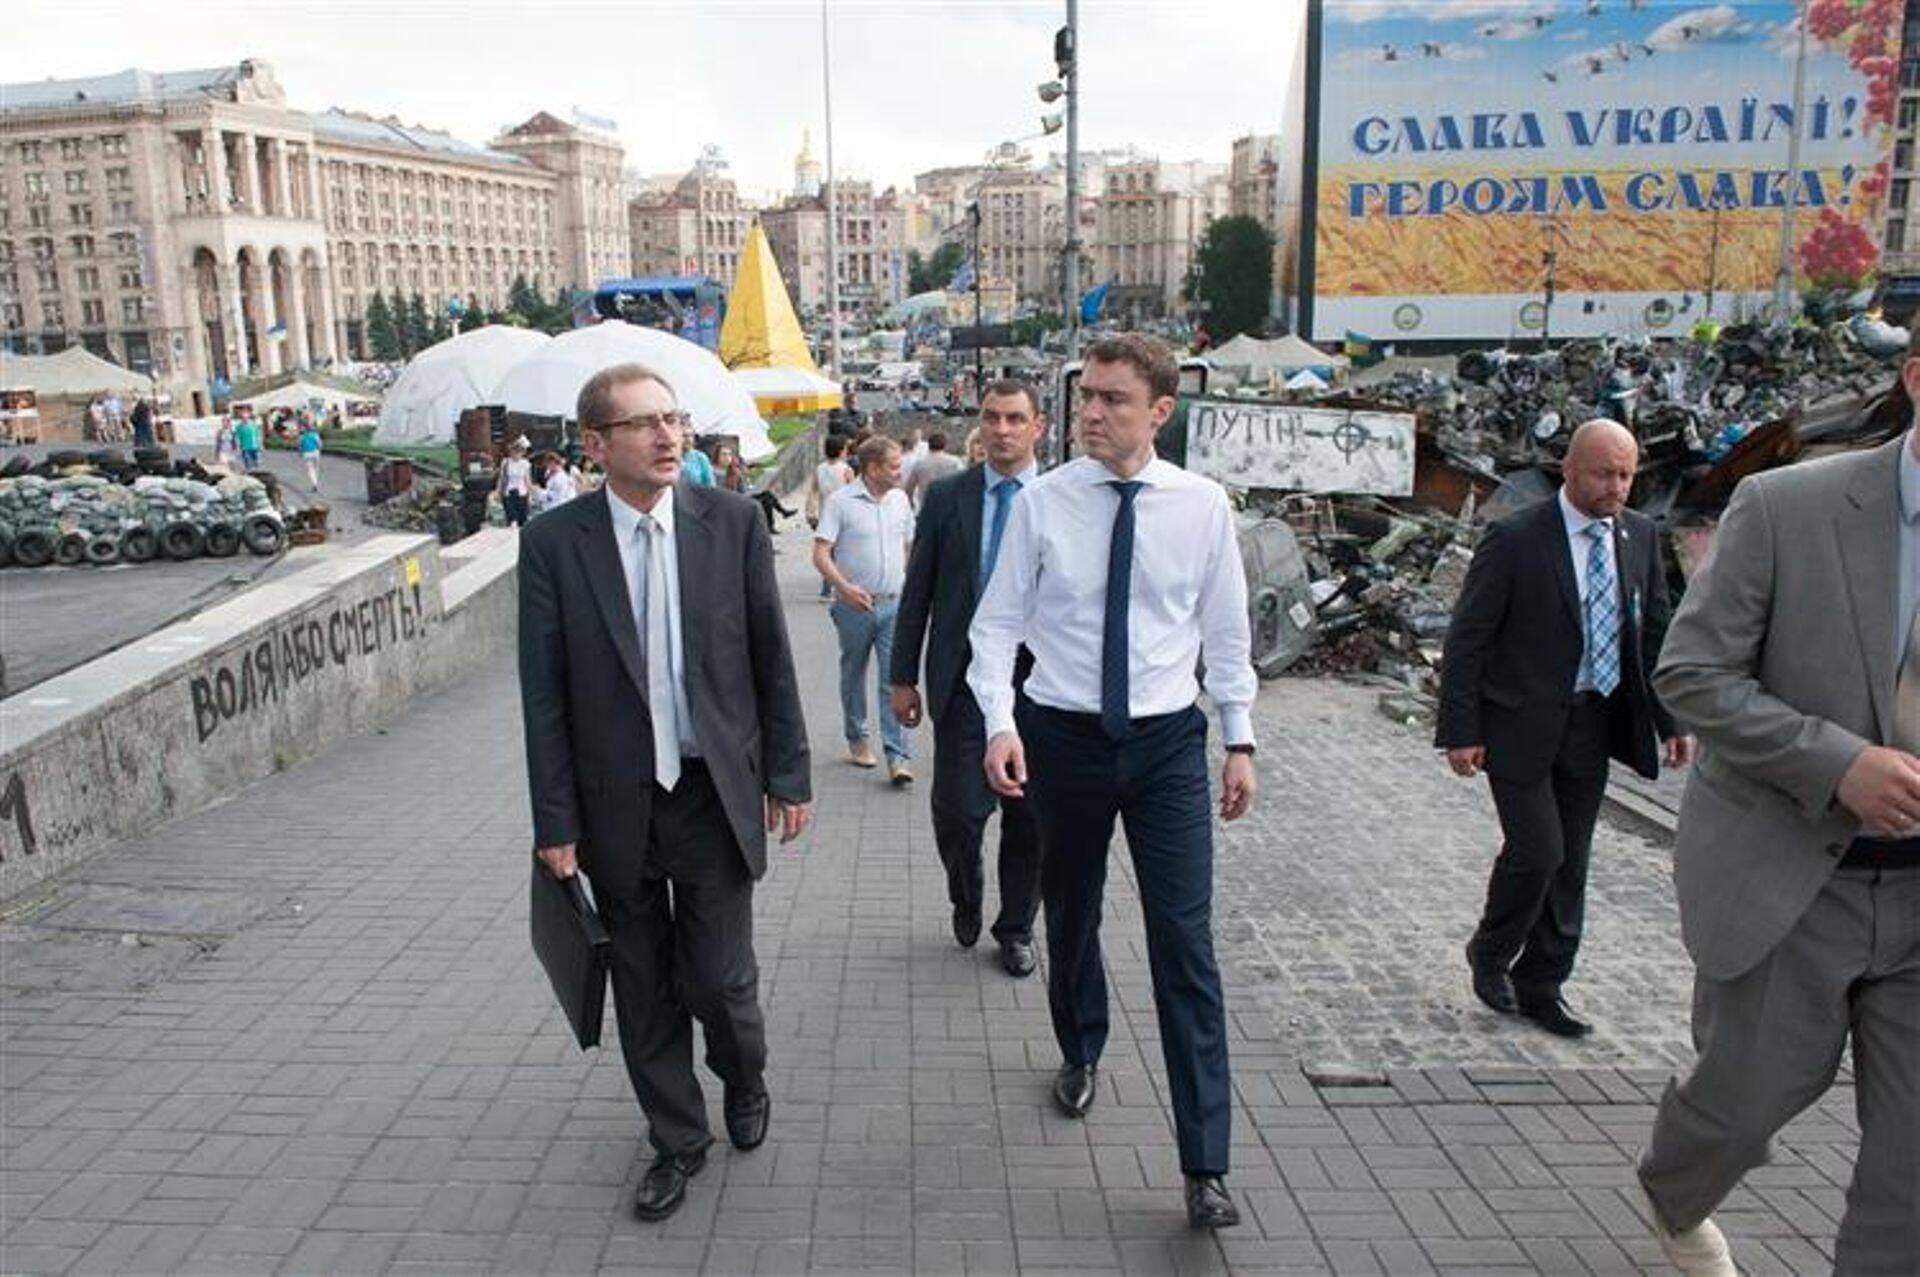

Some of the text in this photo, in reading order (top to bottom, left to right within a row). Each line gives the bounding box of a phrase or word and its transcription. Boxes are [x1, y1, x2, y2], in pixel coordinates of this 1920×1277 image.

[1353, 112, 1546, 154] СЛАВА
[1349, 164, 1855, 217] ГЕРОЯМ СЛАВА!
[1197, 406, 1297, 446] ПУТІН
[191, 583, 425, 744] ВОЛЯ АБО СМЕРТЬ!
